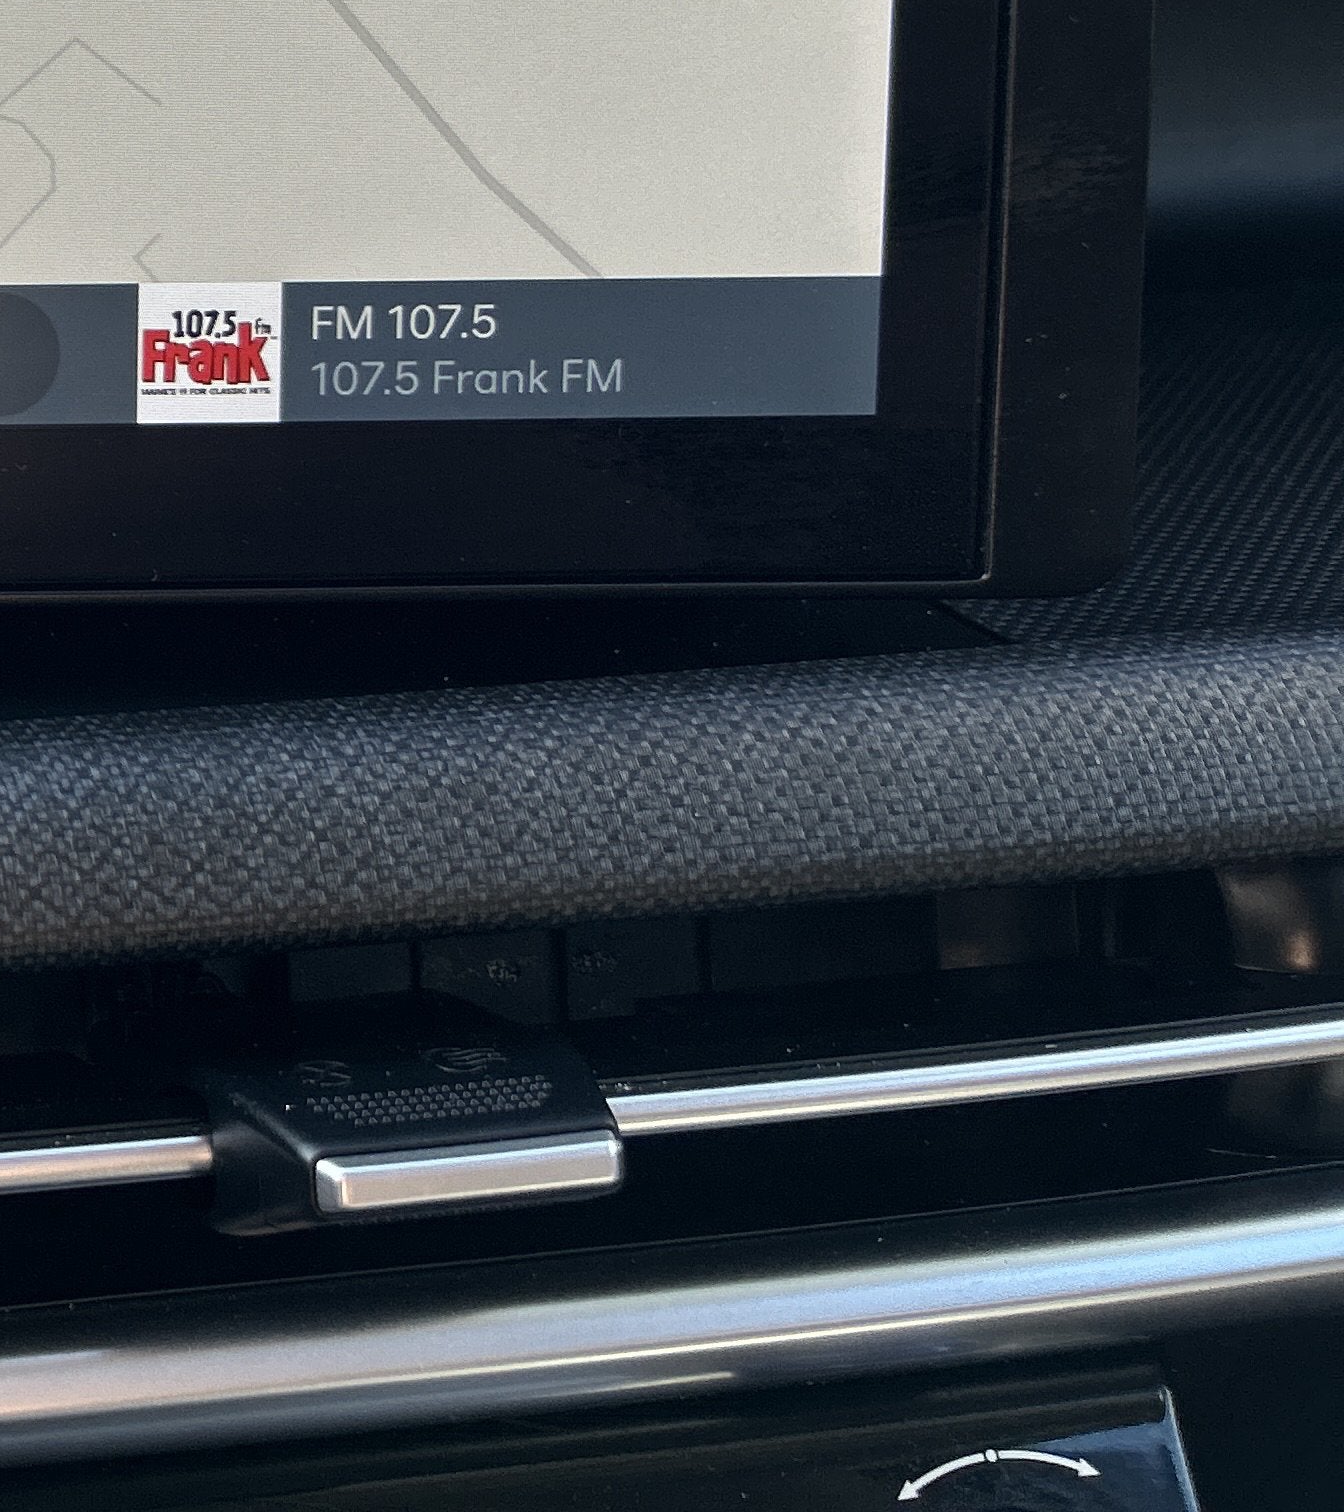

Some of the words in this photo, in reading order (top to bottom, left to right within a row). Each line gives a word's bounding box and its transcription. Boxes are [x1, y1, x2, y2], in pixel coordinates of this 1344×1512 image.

[172, 309, 237, 338] 107.5
[312, 305, 373, 341] FM
[388, 303, 496, 340] 107.5
[142, 321, 271, 385] Frank
[311, 360, 419, 397] 107.5
[433, 359, 549, 395] Frank
[561, 358, 623, 393] FM
